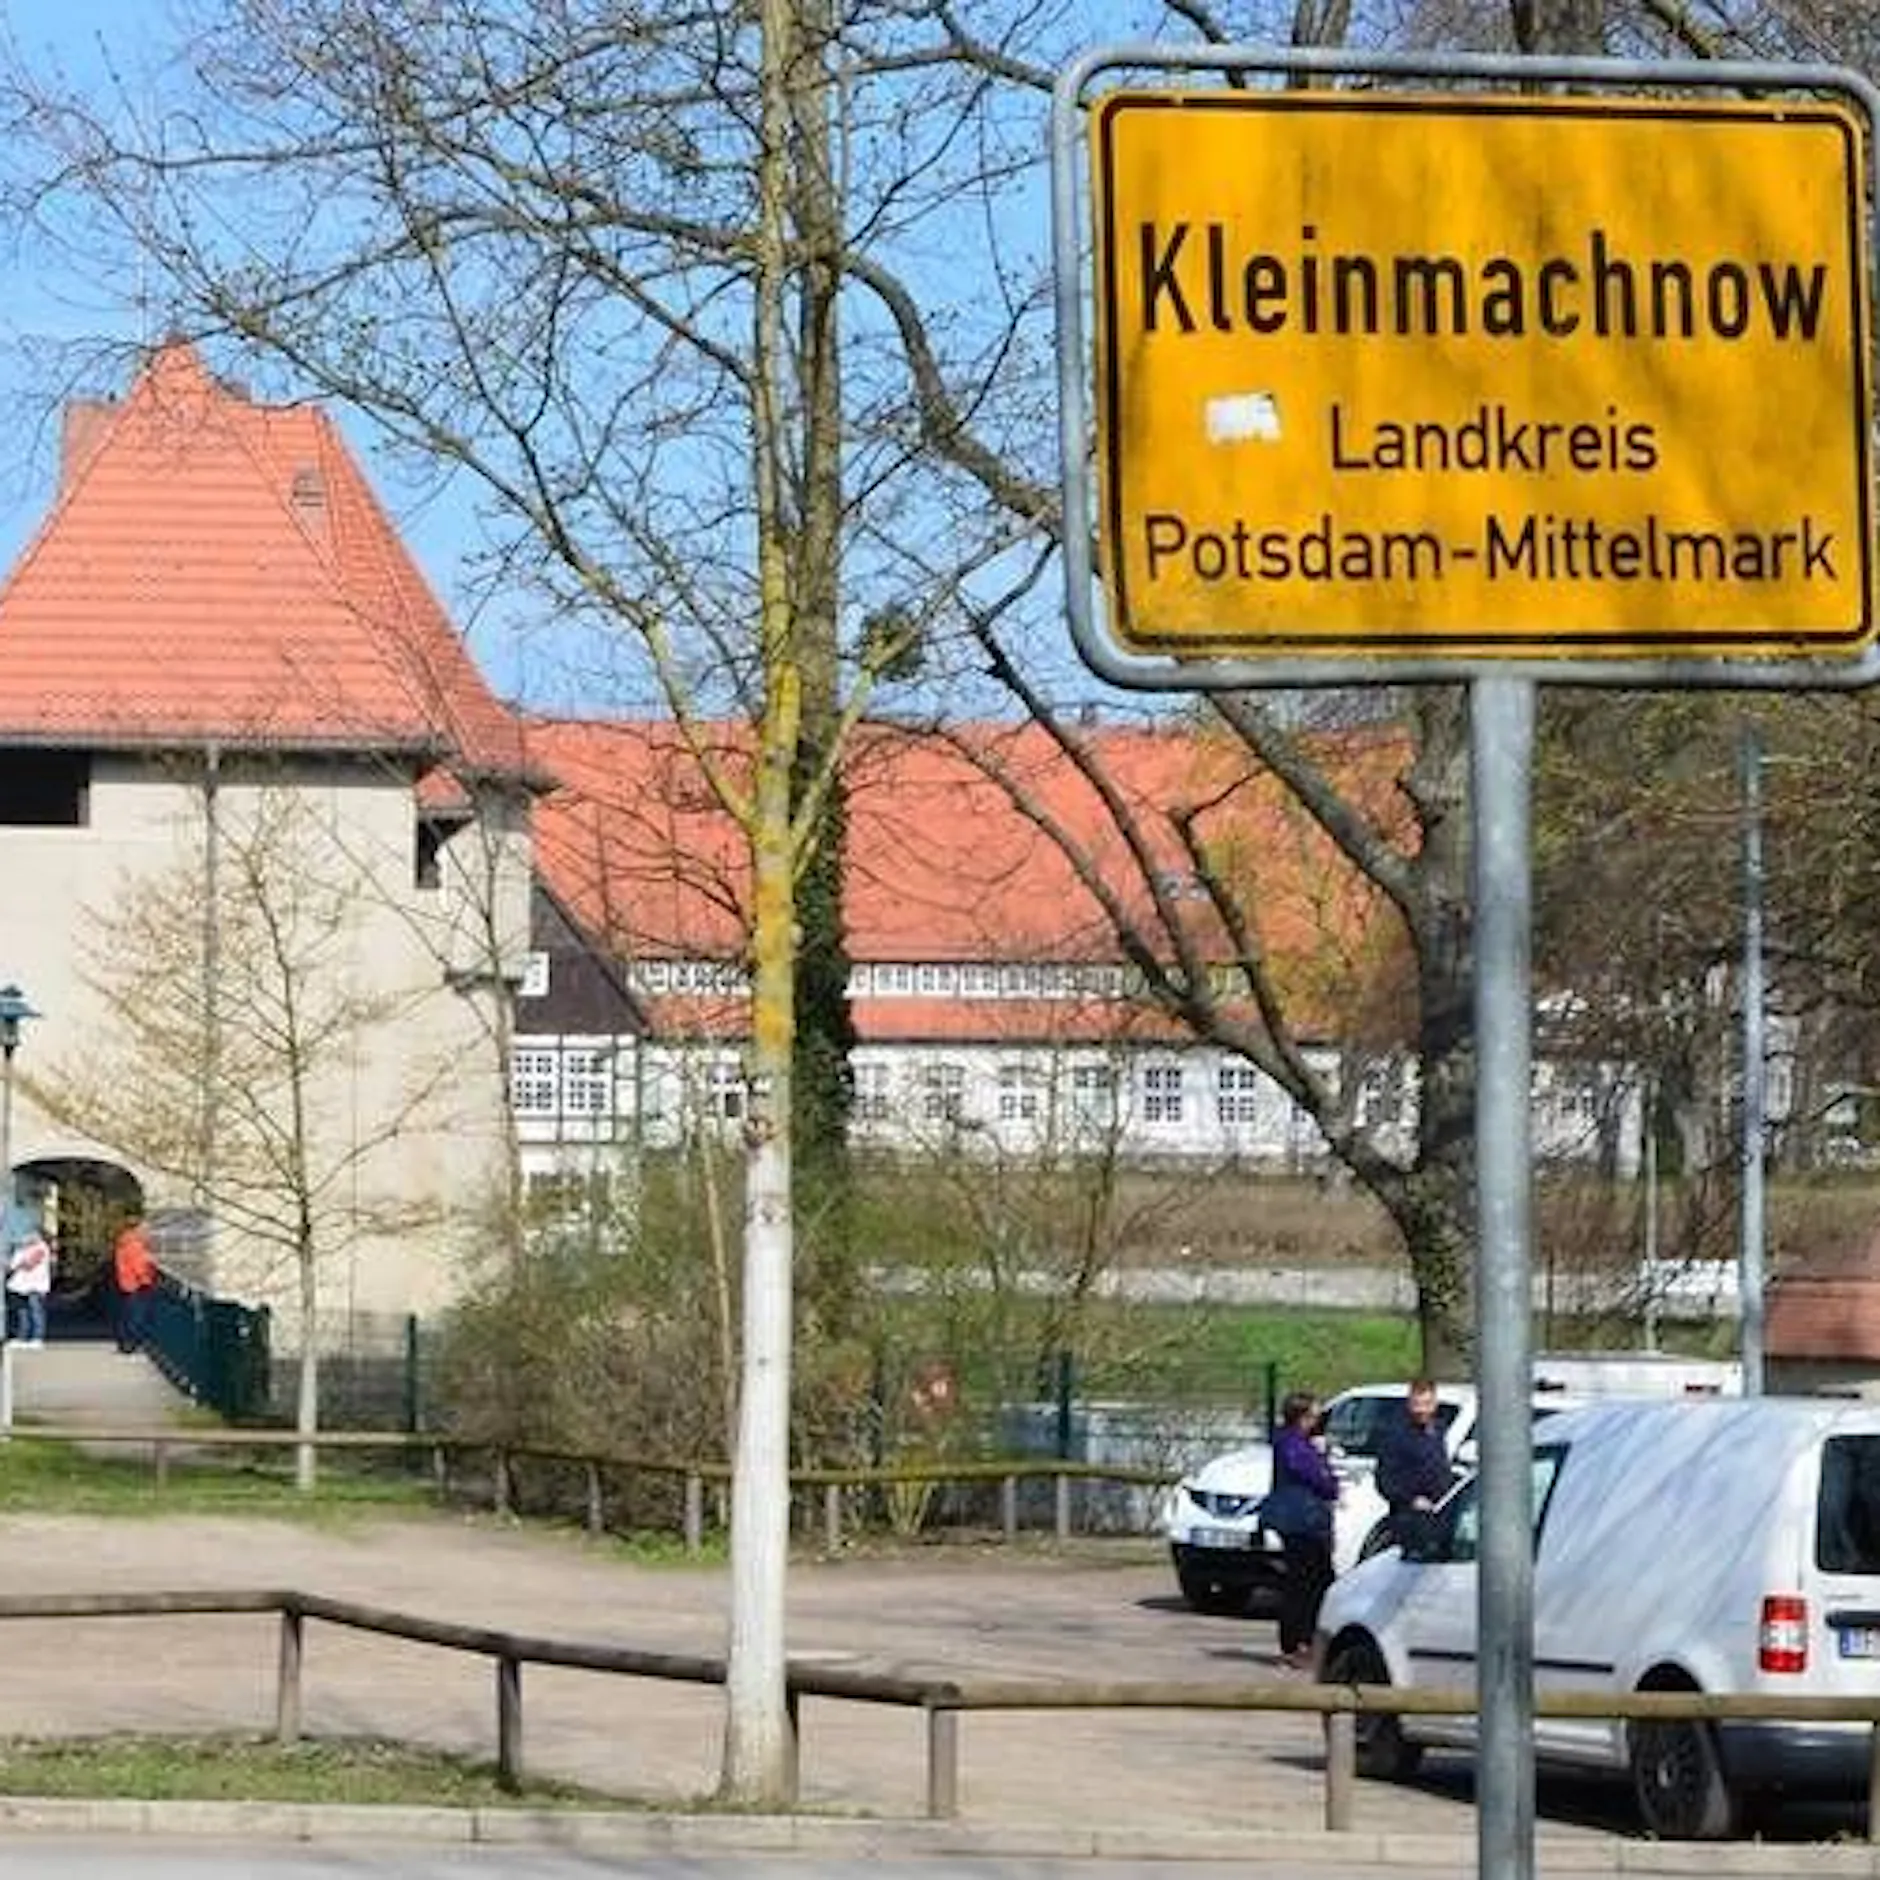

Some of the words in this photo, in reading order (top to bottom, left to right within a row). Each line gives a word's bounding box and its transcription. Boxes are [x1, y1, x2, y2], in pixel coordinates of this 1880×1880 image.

[1139, 222, 1826, 340] Kleinmachnow
[1331, 404, 1659, 471] Landkreis
[1145, 513, 1838, 582] Potsdam-Mittelmark
